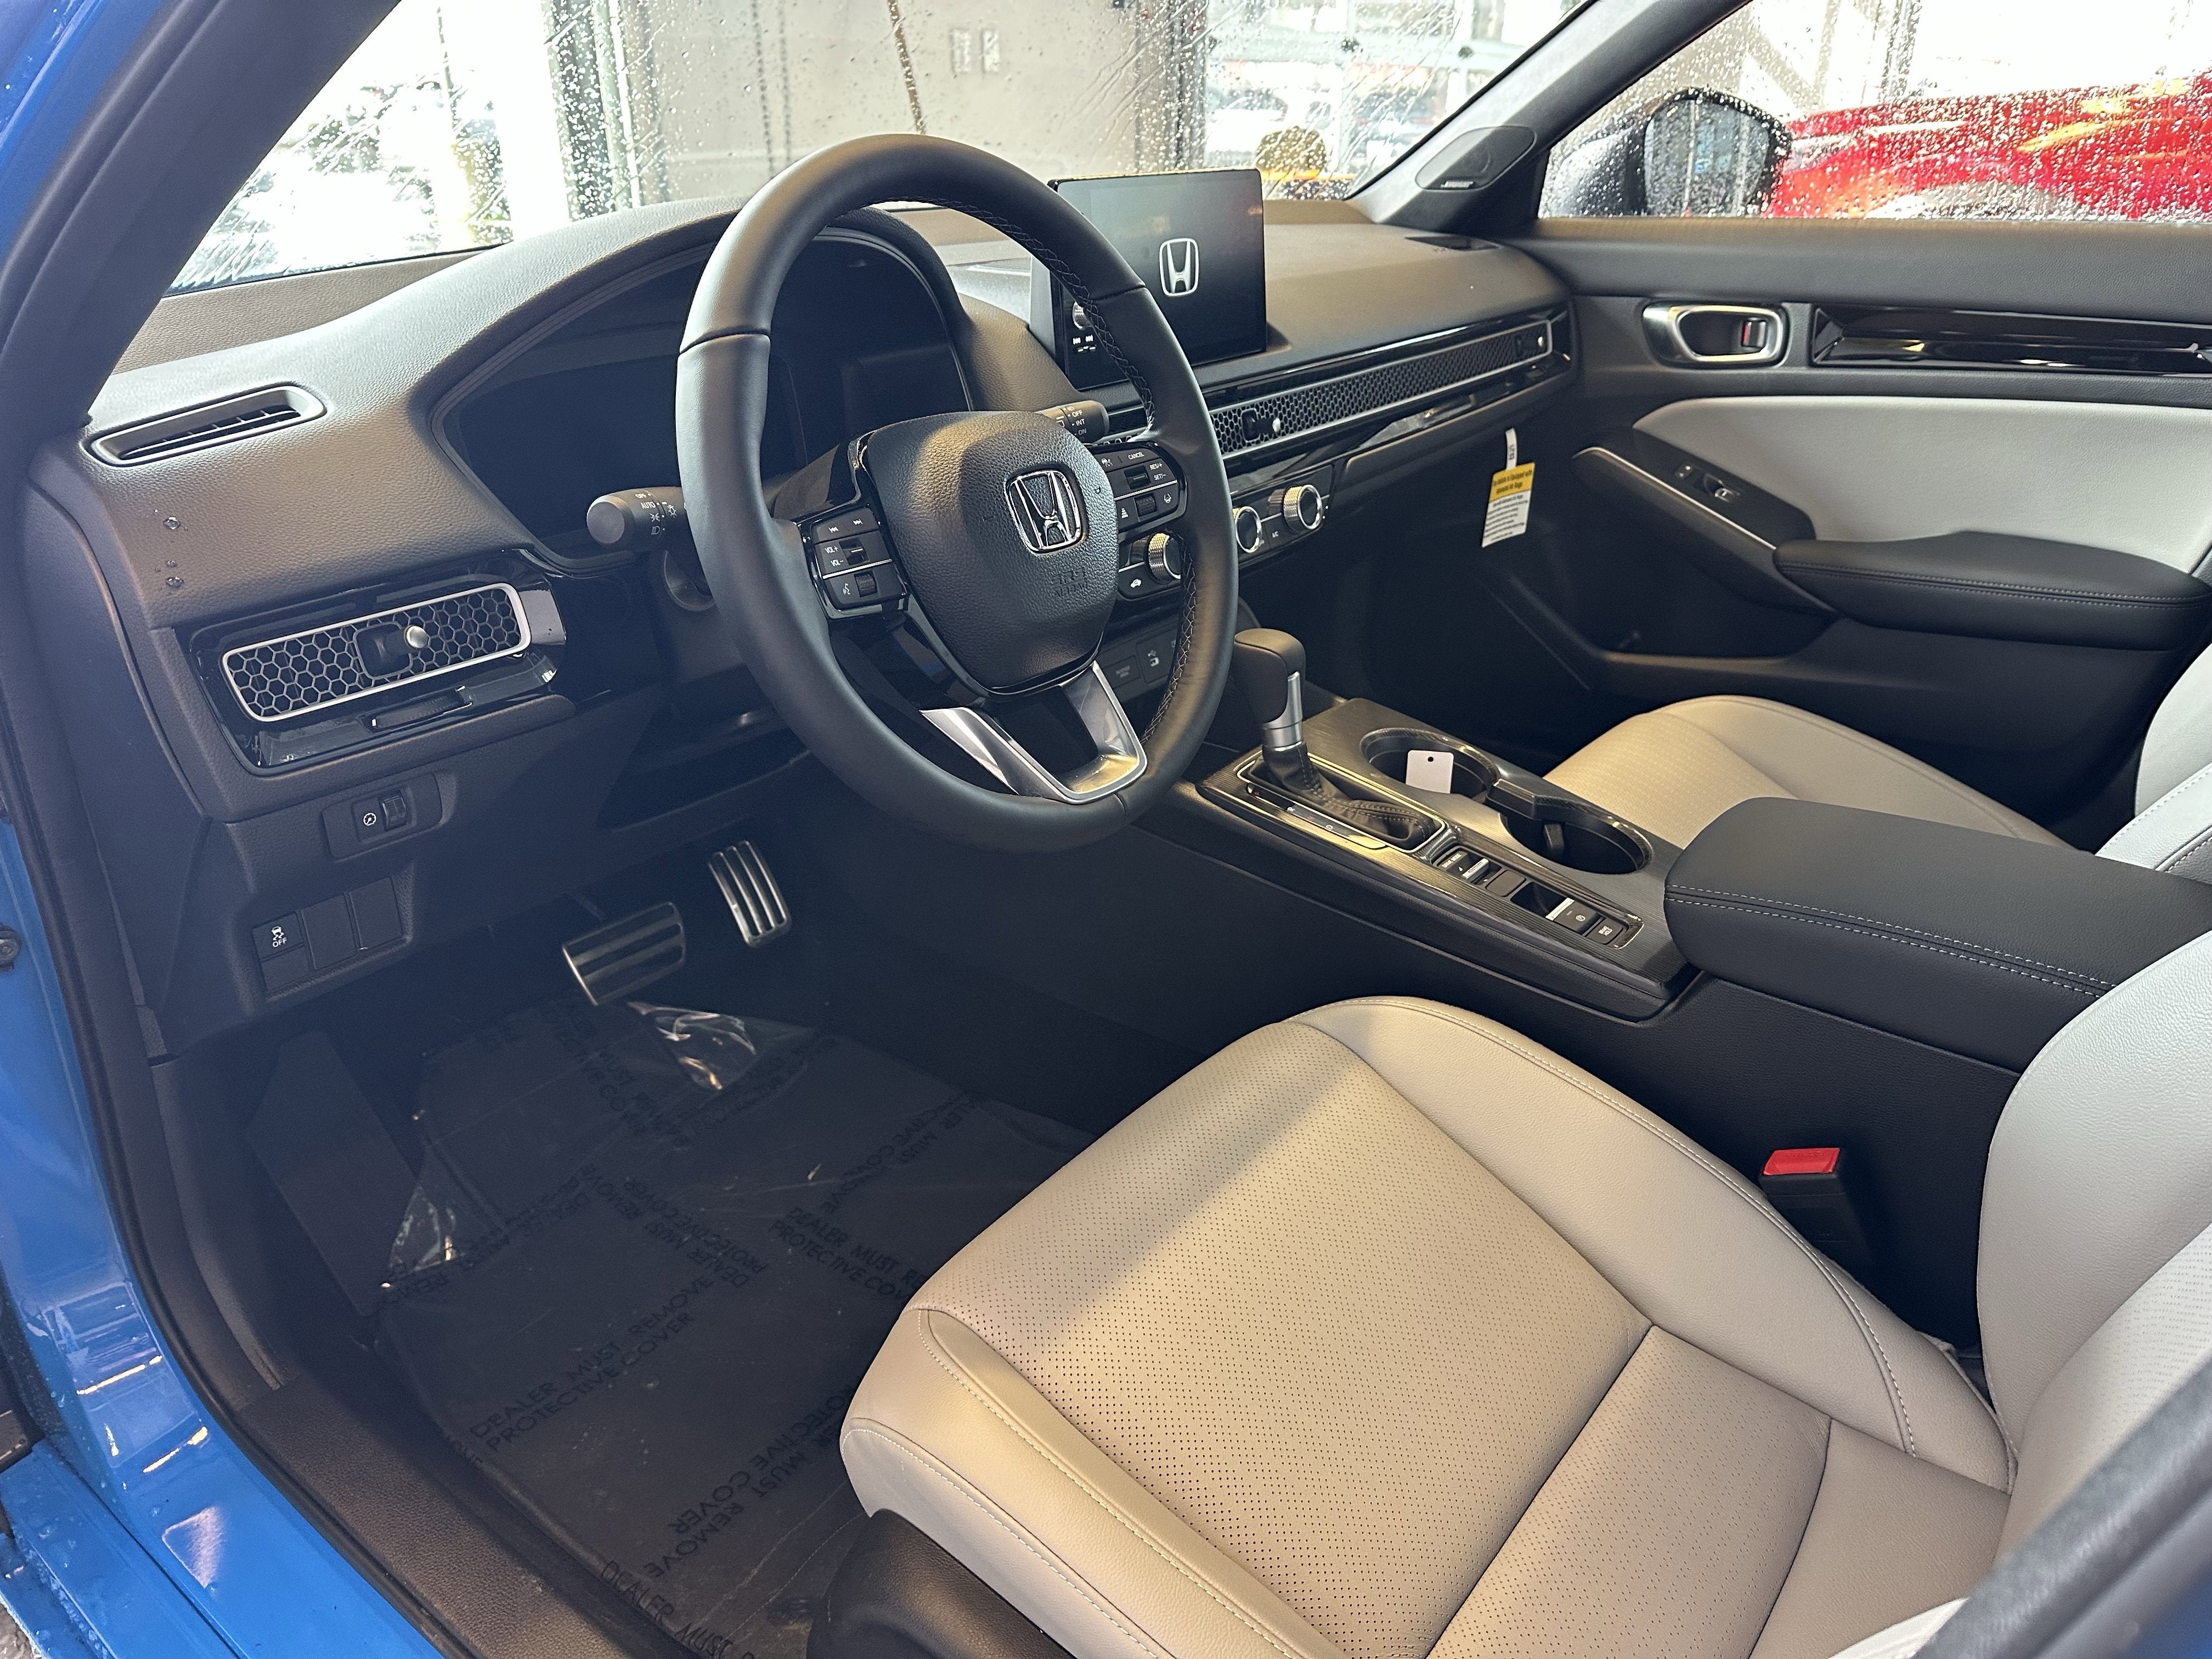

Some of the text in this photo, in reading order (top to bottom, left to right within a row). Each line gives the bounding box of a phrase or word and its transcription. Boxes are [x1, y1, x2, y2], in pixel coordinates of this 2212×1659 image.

[640, 501, 656, 509] AUTO
[824, 545, 838, 554] VOL+
[272, 937, 287, 947] OFF
[768, 1219, 868, 1283] PROTECTIVE
[785, 1206, 900, 1274] DEALER MUST
[470, 1274, 714, 1438] DEALER MUST REMOVE
[486, 1366, 622, 1452] PROTECTIVE
[620, 1311, 696, 1365] COVER
[642, 1451, 807, 1578] MUST REMOVE
[667, 1470, 752, 1534] COVER
[600, 1560, 676, 1627] DEALER
